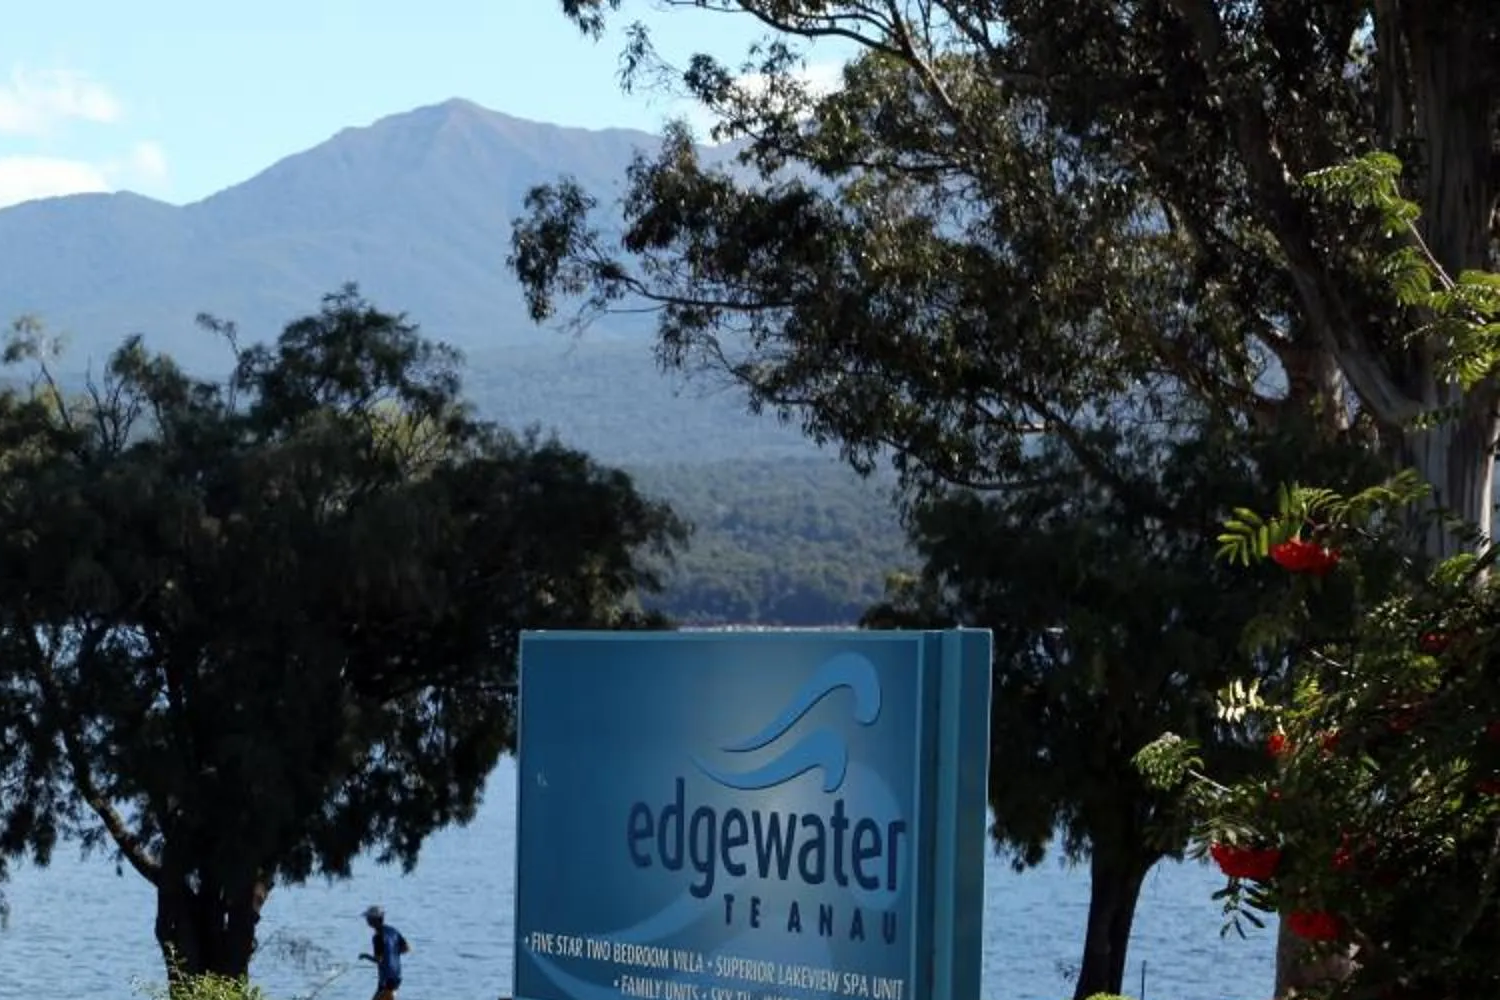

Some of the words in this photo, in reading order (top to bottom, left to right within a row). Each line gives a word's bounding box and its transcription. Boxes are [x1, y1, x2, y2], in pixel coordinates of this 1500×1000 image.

[627, 776, 906, 899] edgewater
[724, 893, 761, 928] TE
[786, 902, 897, 944] ANAU
[532, 932, 553, 954] FIVE
[556, 935, 583, 958] STAR
[587, 938, 611, 961] TWO
[613, 942, 670, 968] BEDROOM
[673, 950, 704, 973] VILLA
[716, 956, 776, 985] SUPERIOR
[778, 964, 840, 993] LAKEVIEW
[843, 972, 869, 997] SPA
[621, 976, 661, 999] FAMILY
